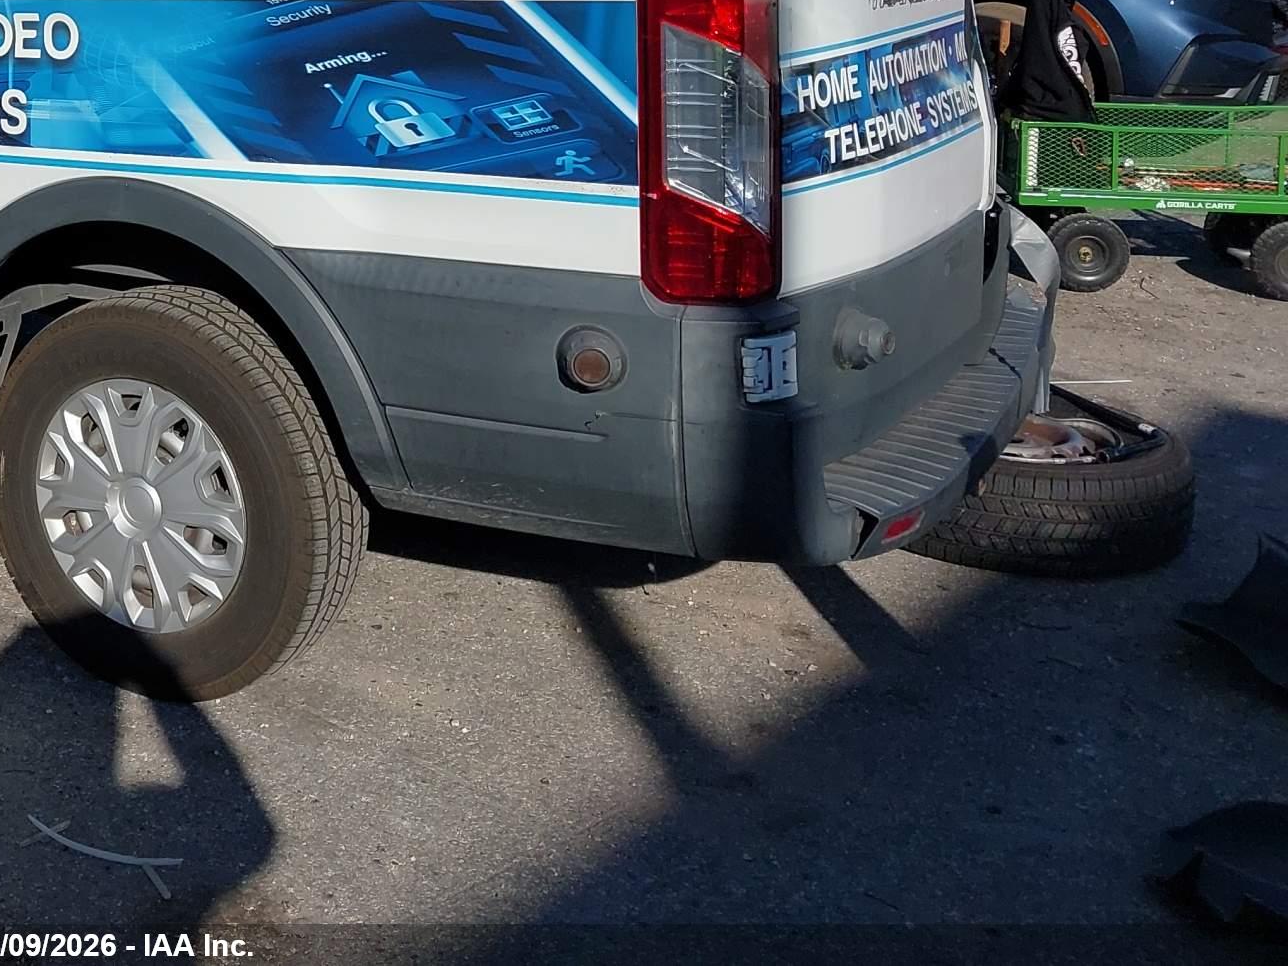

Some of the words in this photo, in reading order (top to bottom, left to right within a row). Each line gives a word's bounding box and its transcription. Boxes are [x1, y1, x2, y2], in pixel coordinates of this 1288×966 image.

[265, 3, 332, 27] Security
[304, 51, 388, 74] Arming...
[797, 64, 862, 113] HOME
[868, 37, 948, 95] AUTOMATION
[512, 124, 561, 138] Sensors
[824, 101, 927, 165] TELEPHONE
[926, 80, 978, 129] SYSTEMS
[1167, 201, 1203, 209] GORILLA
